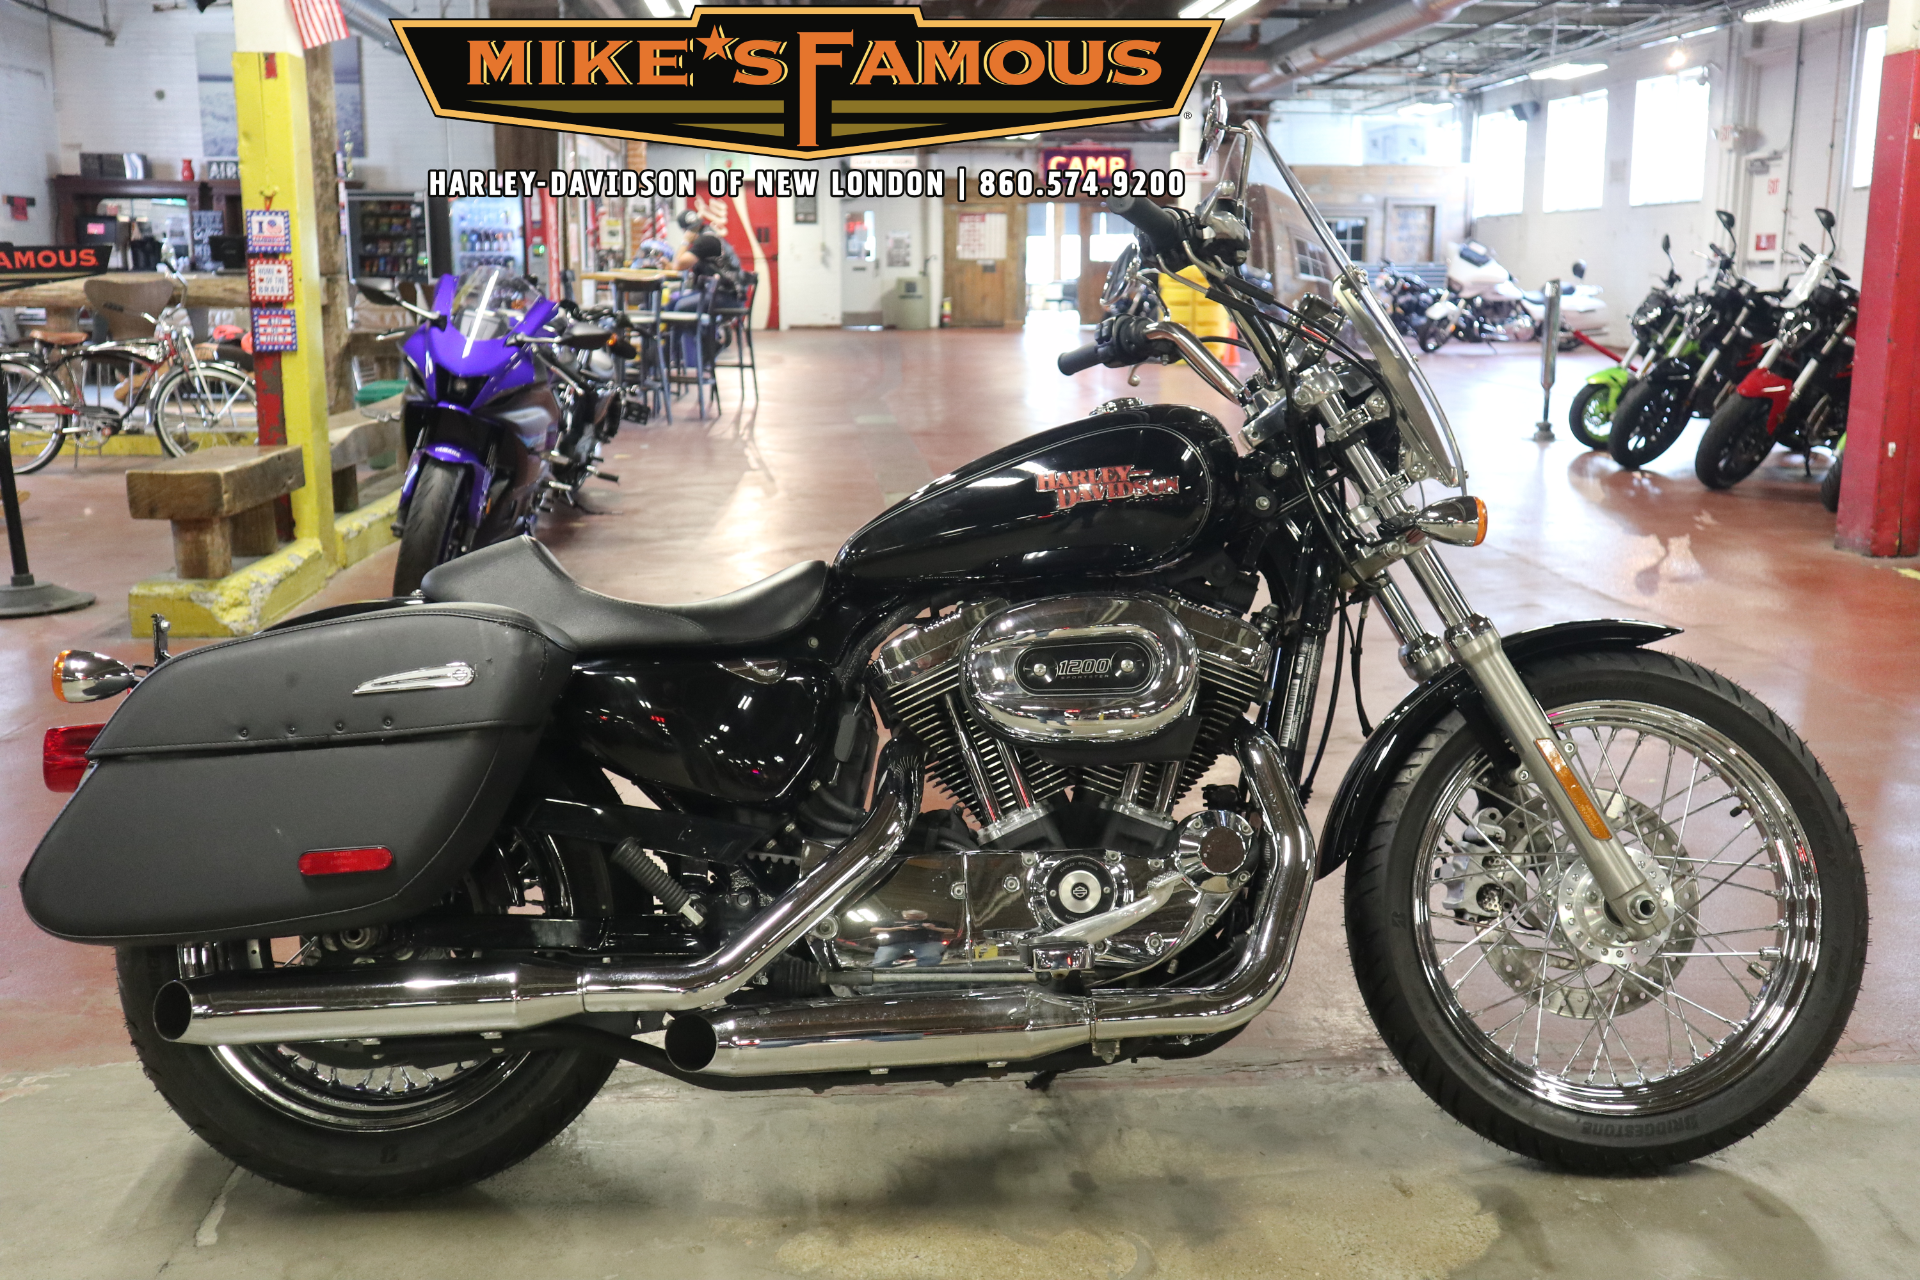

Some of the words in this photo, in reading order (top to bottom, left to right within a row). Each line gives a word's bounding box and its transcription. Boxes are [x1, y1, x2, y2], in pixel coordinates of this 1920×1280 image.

[1048, 156, 1127, 178] CAMP
[258, 285, 285, 293] BRAVE
[1055, 475, 1180, 510] DAVIDSON
[1057, 658, 1112, 675] 1200
[1581, 1114, 1699, 1138] BRIDGESTONE
